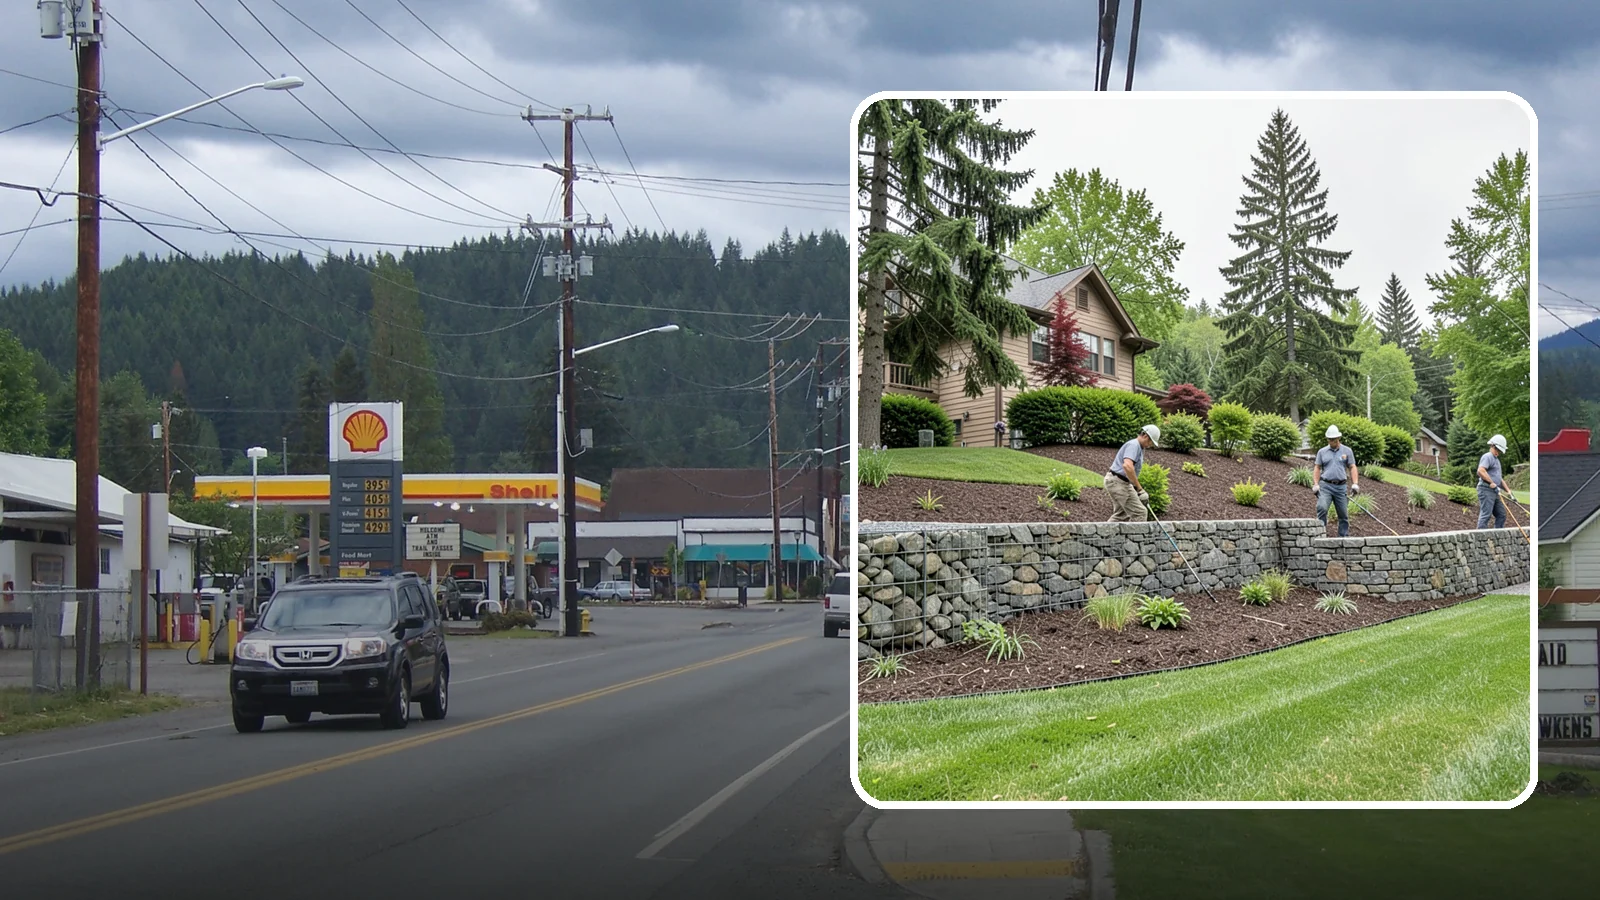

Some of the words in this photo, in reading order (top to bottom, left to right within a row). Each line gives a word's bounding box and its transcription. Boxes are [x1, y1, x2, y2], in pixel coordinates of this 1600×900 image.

[366, 480, 383, 490] 395
[490, 484, 547, 499] Shell
[366, 494, 383, 504] 405
[366, 507, 383, 518] 415
[366, 522, 383, 532] 429
